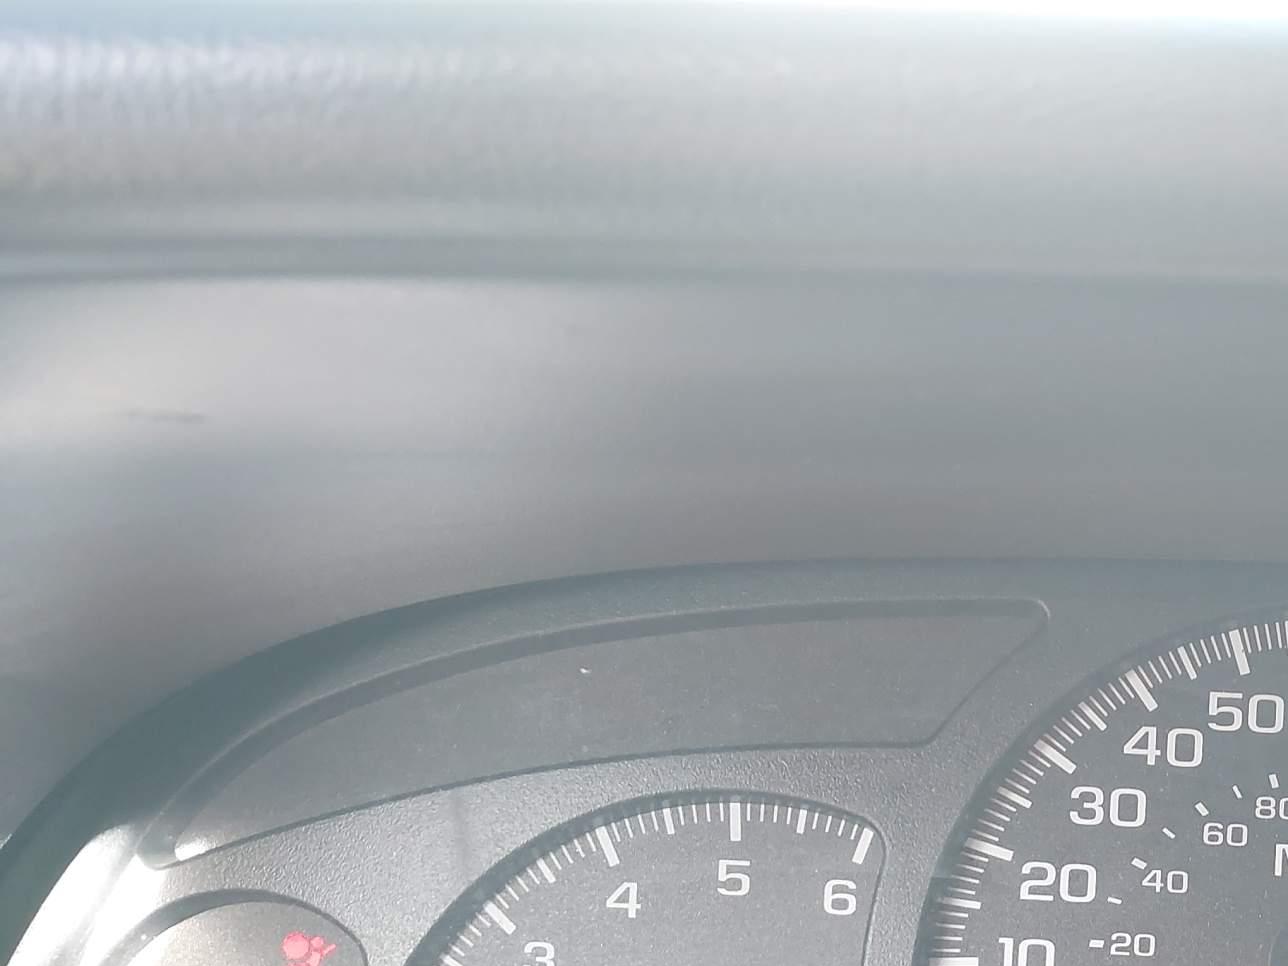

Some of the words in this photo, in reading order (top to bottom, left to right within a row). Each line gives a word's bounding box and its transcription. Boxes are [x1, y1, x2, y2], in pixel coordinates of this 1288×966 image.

[1208, 691, 1284, 733] 50
[1123, 726, 1203, 767] 40
[1070, 786, 1146, 827] 30
[1202, 823, 1248, 846] 60
[717, 860, 750, 896] 5
[1020, 862, 1096, 903] 20
[1142, 870, 1188, 894] 40
[606, 882, 640, 917] 4
[823, 880, 857, 915] 6
[1110, 933, 1155, 957] 20
